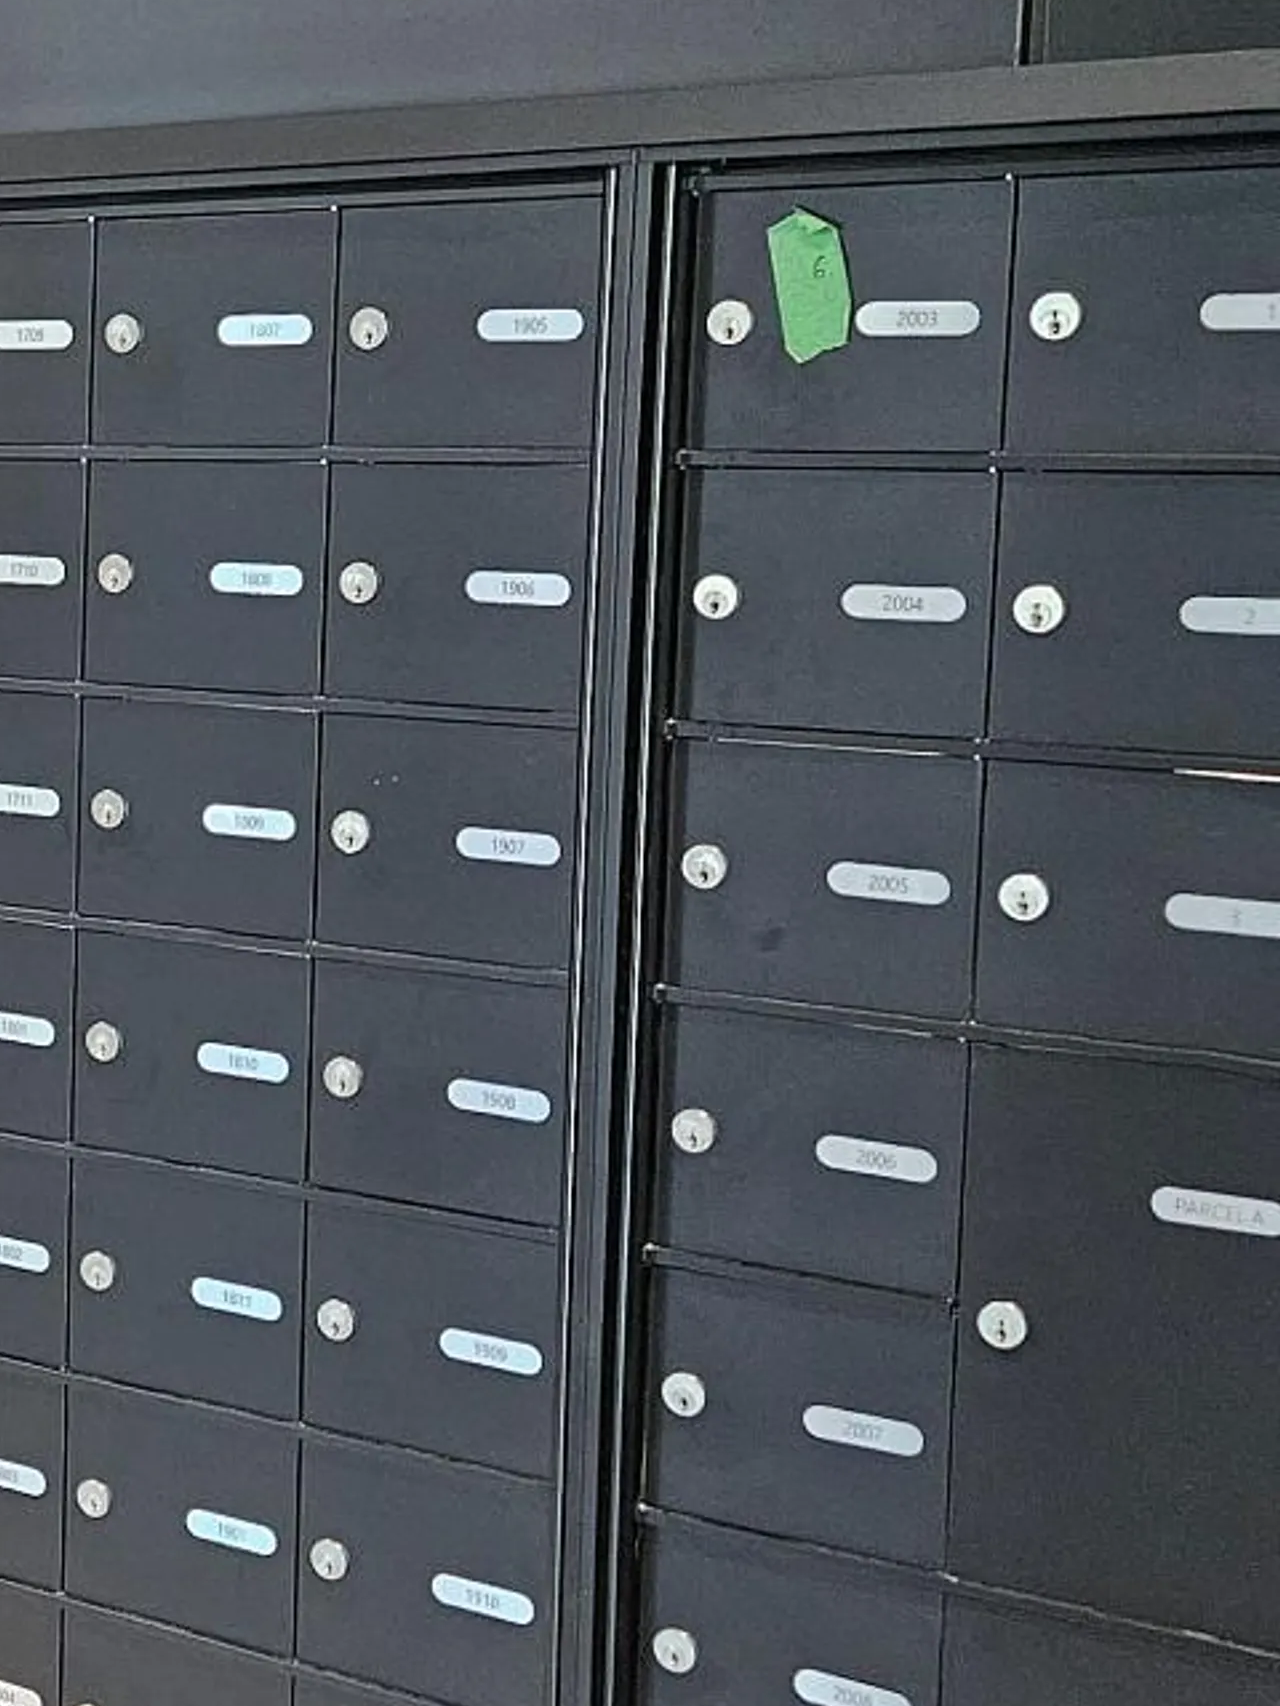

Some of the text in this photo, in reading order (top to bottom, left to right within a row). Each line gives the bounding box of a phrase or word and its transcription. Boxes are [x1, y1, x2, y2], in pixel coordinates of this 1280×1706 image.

[514, 317, 548, 334] 1905
[896, 310, 937, 328] 2003
[882, 595, 924, 612] 2004
[492, 836, 525, 854] 1907
[868, 874, 909, 894] 2005
[856, 1149, 897, 1170] 2006
[1175, 1197, 1250, 1224] PARCEL
